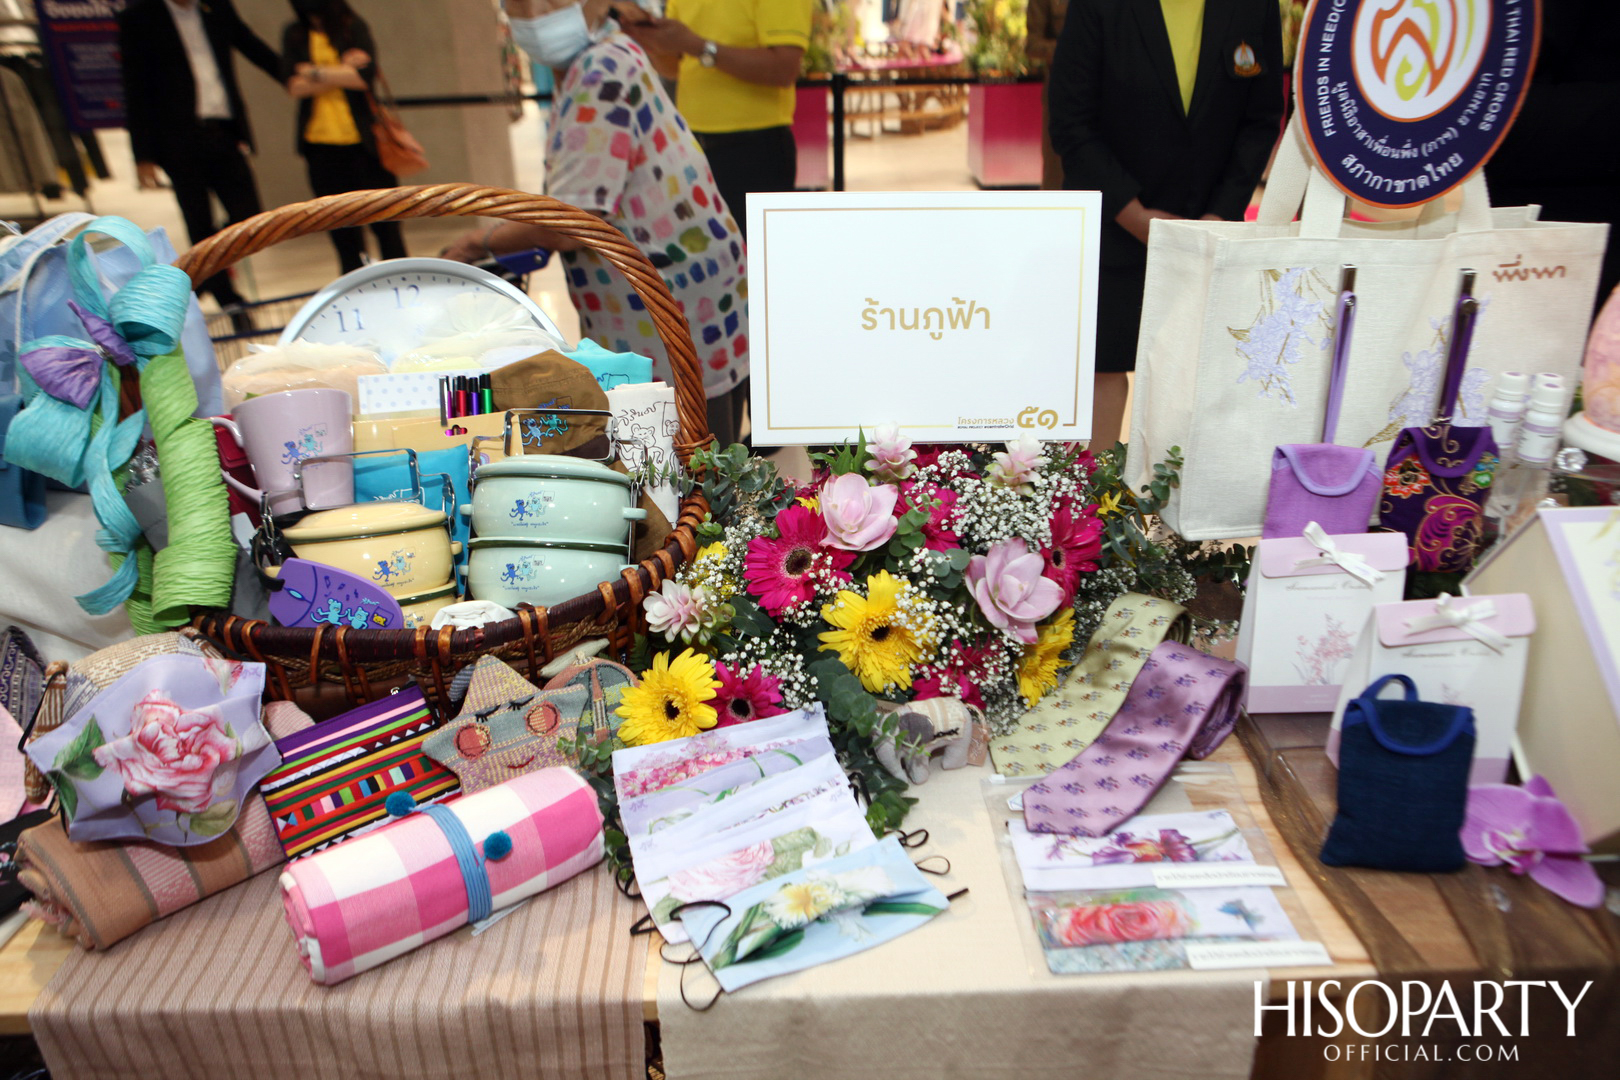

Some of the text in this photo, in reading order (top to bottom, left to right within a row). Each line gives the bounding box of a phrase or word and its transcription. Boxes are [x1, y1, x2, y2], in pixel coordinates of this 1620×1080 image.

[1505, 6, 1522, 43] THAI
[1317, 57, 1331, 72] IN
[1499, 47, 1519, 78] RED
[1316, 75, 1337, 137] FRIENDS
[1477, 82, 1510, 131] CROSS
[1341, 153, 1464, 193] สภากาชาดไทย
[391, 283, 422, 309] 12
[335, 307, 366, 333] 11
[861, 296, 991, 341] ร้านภูฟ้า
[957, 405, 1059, 430] โครงการหลวง ๕๑
